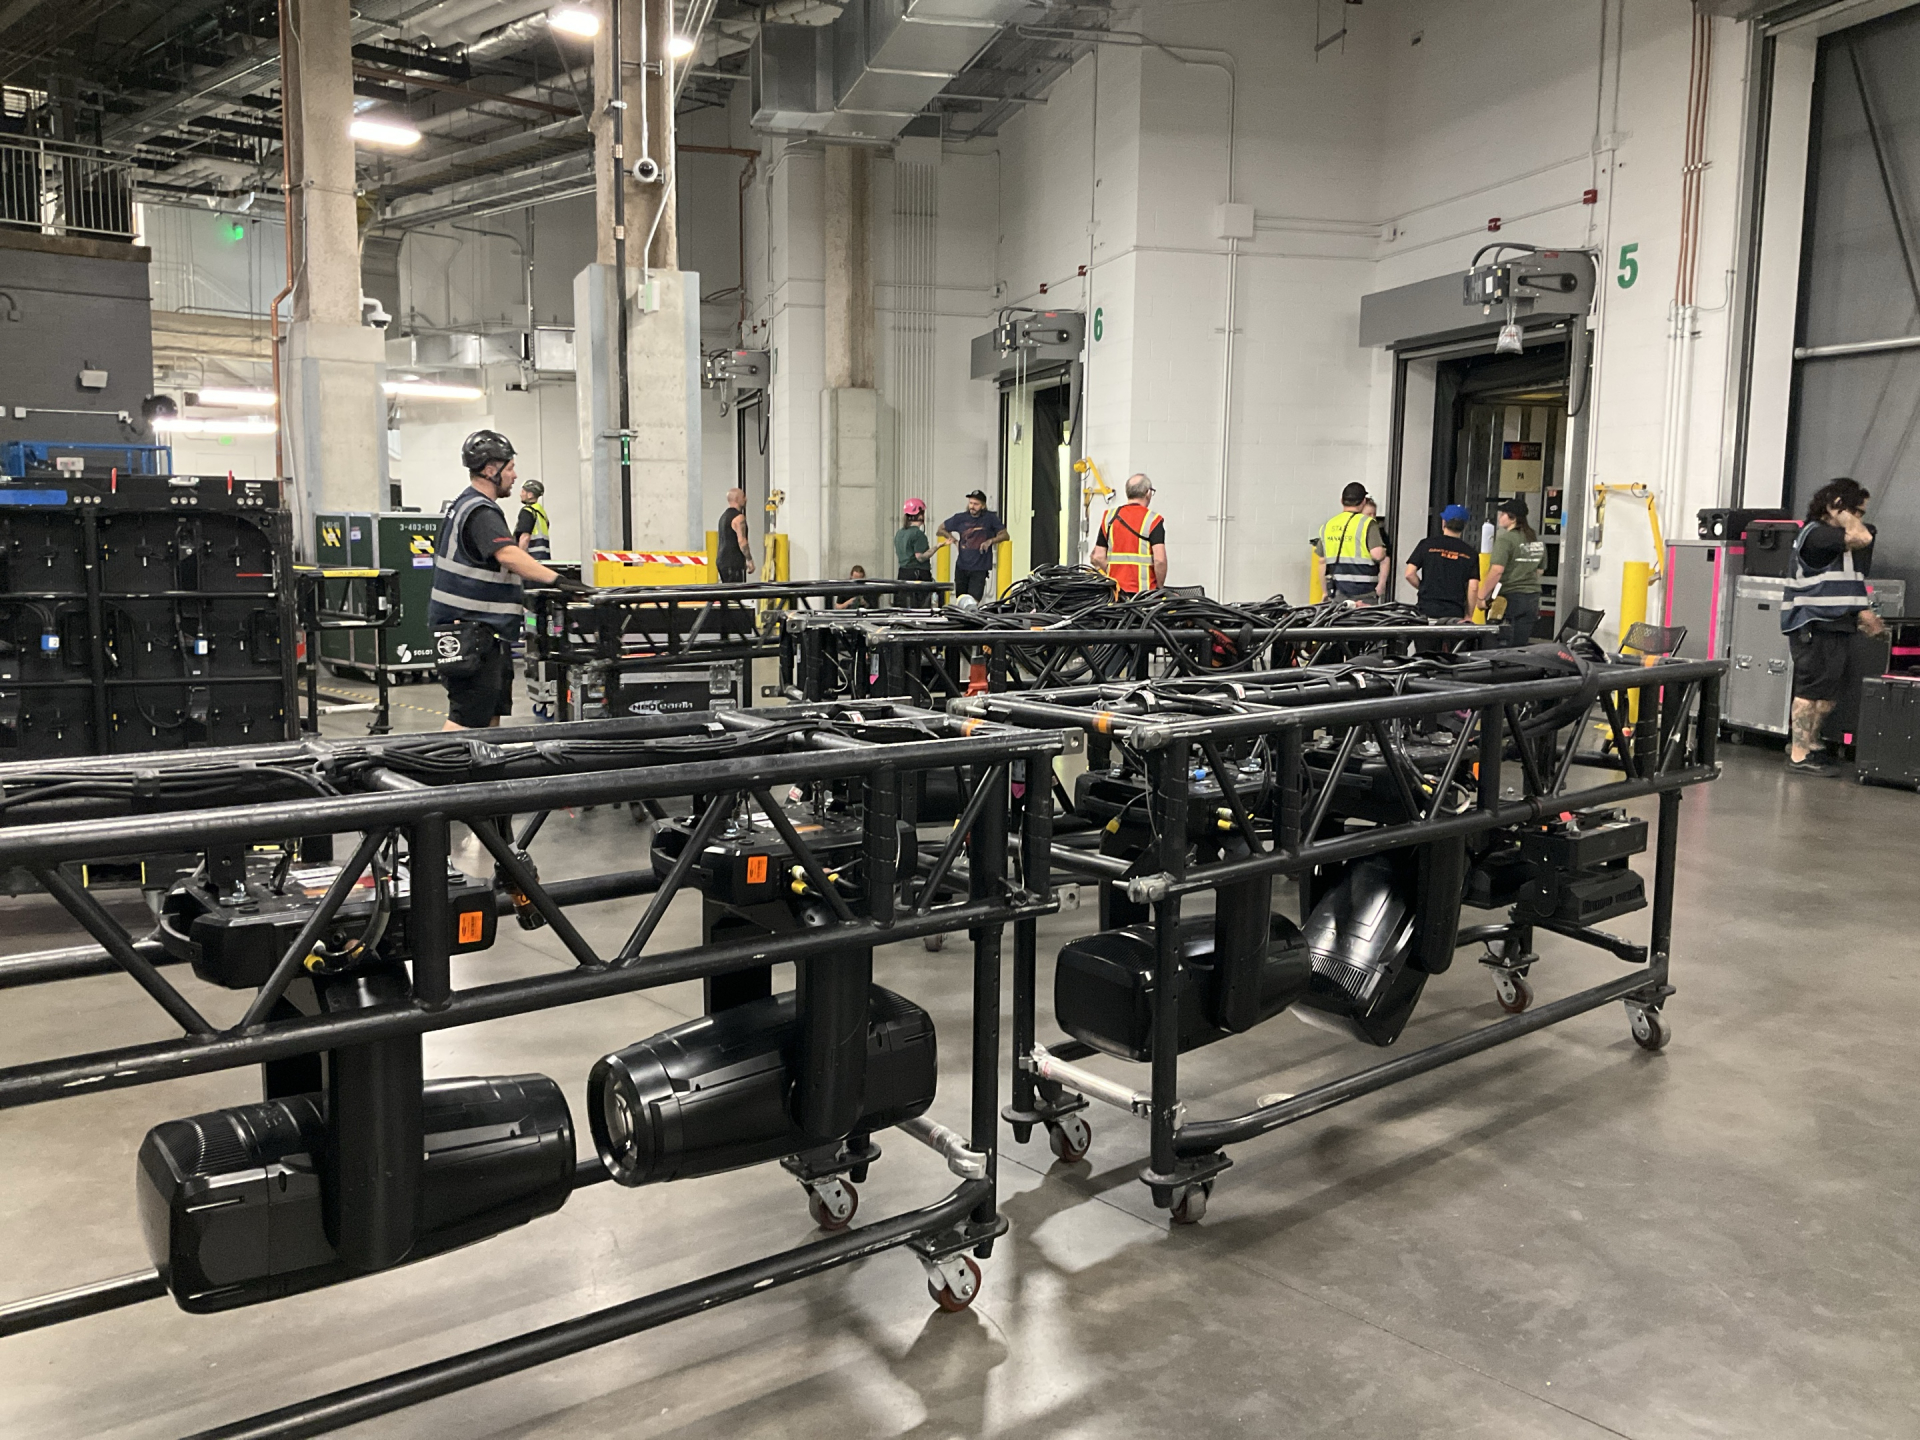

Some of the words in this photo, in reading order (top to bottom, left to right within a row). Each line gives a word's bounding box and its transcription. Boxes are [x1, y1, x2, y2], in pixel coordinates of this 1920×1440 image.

[1617, 242, 1639, 289] 5
[1093, 307, 1103, 342] 6
[1517, 472, 1525, 480] PA
[1327, 535, 1354, 543] MANAER
